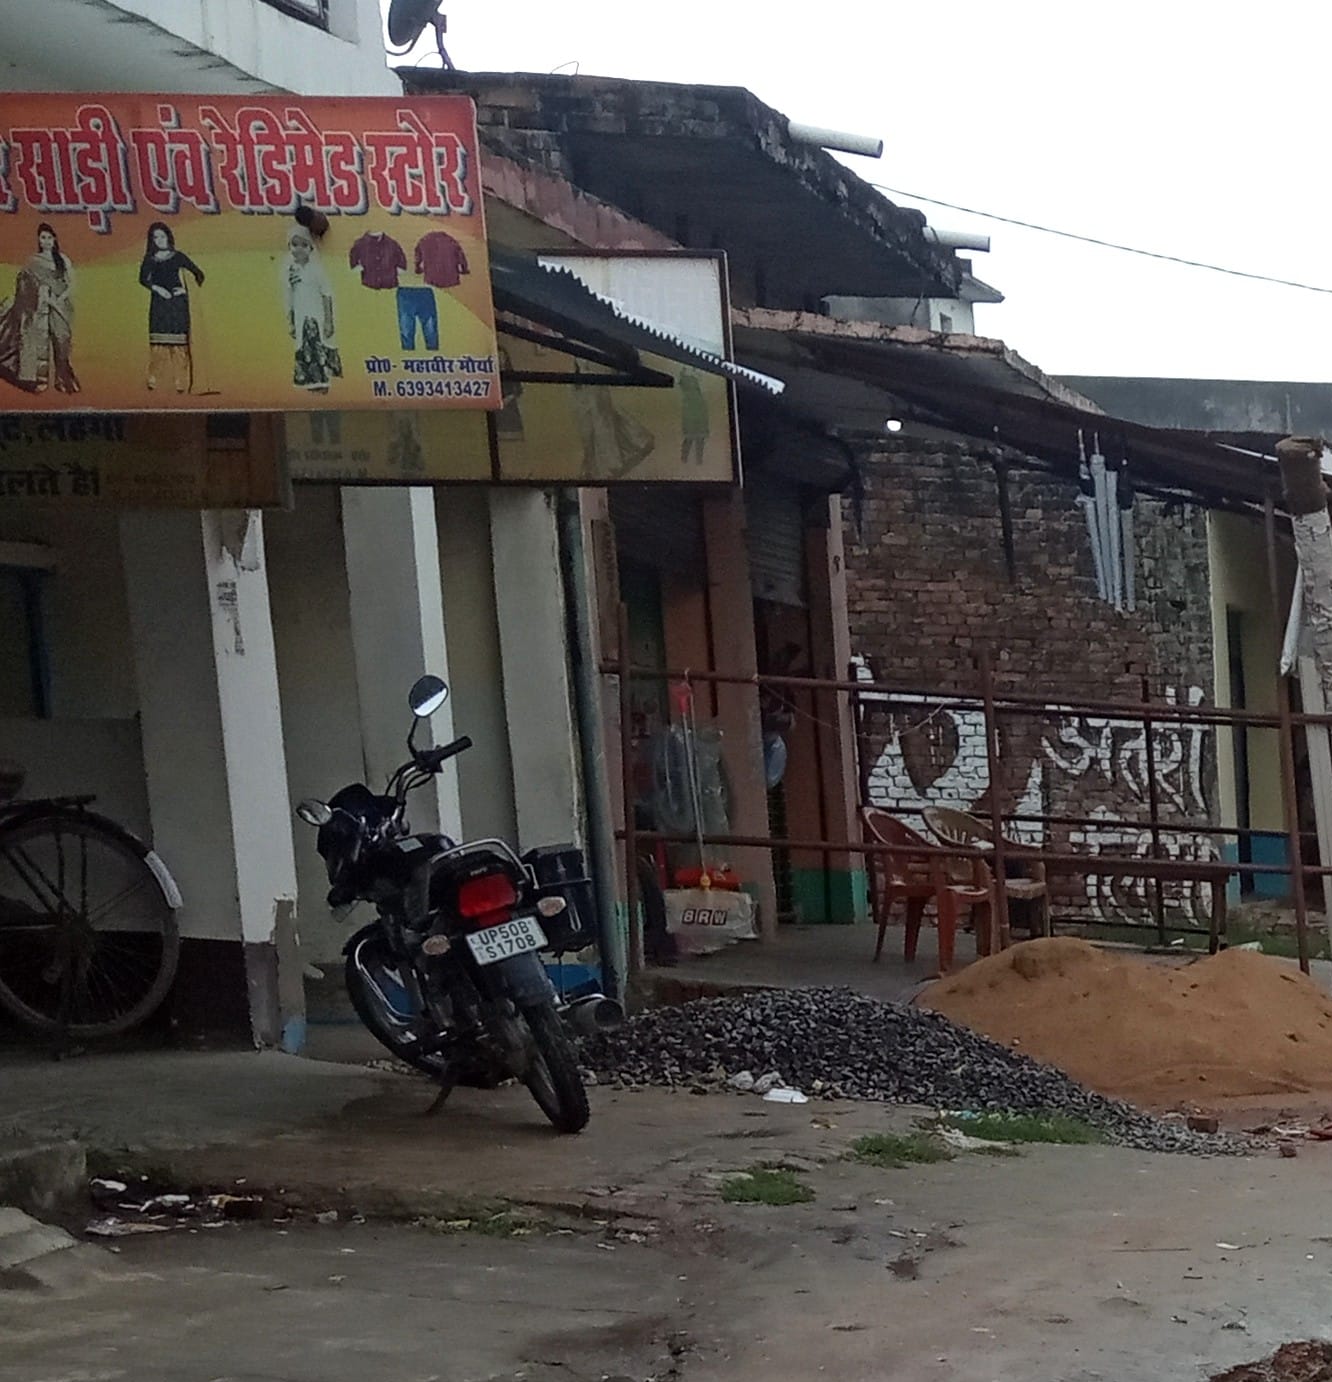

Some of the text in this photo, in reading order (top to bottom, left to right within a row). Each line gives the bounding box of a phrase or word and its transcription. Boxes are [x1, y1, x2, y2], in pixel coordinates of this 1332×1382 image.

[9, 103, 134, 234] साड़ी
[200, 105, 366, 214] रेडिमेड
[362, 108, 474, 216] स्टोर
[402, 356, 455, 373] महावीर
[373, 381, 491, 396] M. 6393413427
[478, 921, 530, 945] UP50B
[486, 934, 537, 959] S1708
